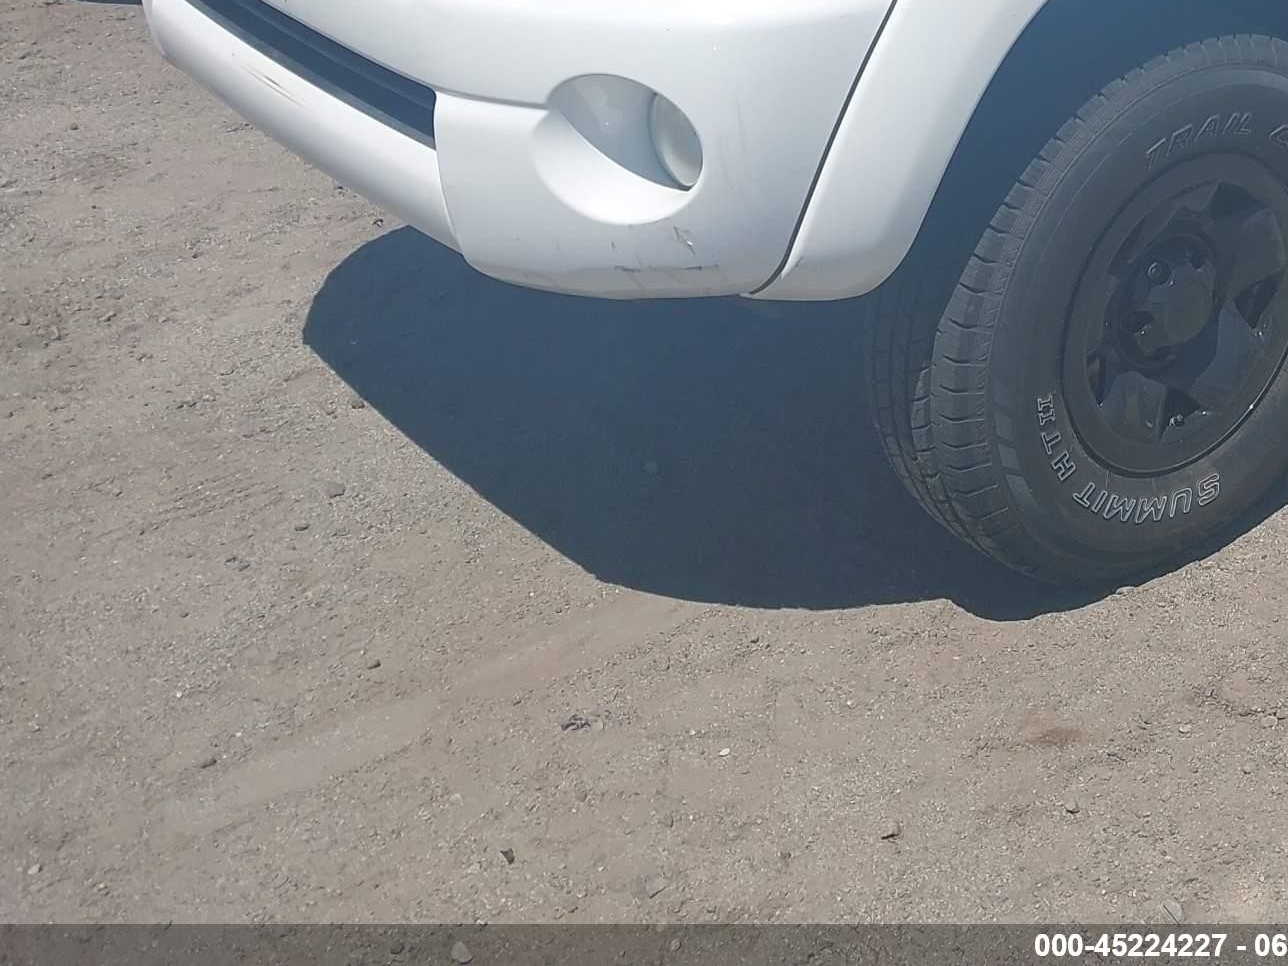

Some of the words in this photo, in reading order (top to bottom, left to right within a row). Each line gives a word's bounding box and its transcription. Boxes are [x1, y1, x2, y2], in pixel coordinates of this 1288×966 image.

[1146, 111, 1252, 171] TRAIL
[1040, 431, 1077, 482] HT
[1072, 472, 1221, 525] SUMMIT
